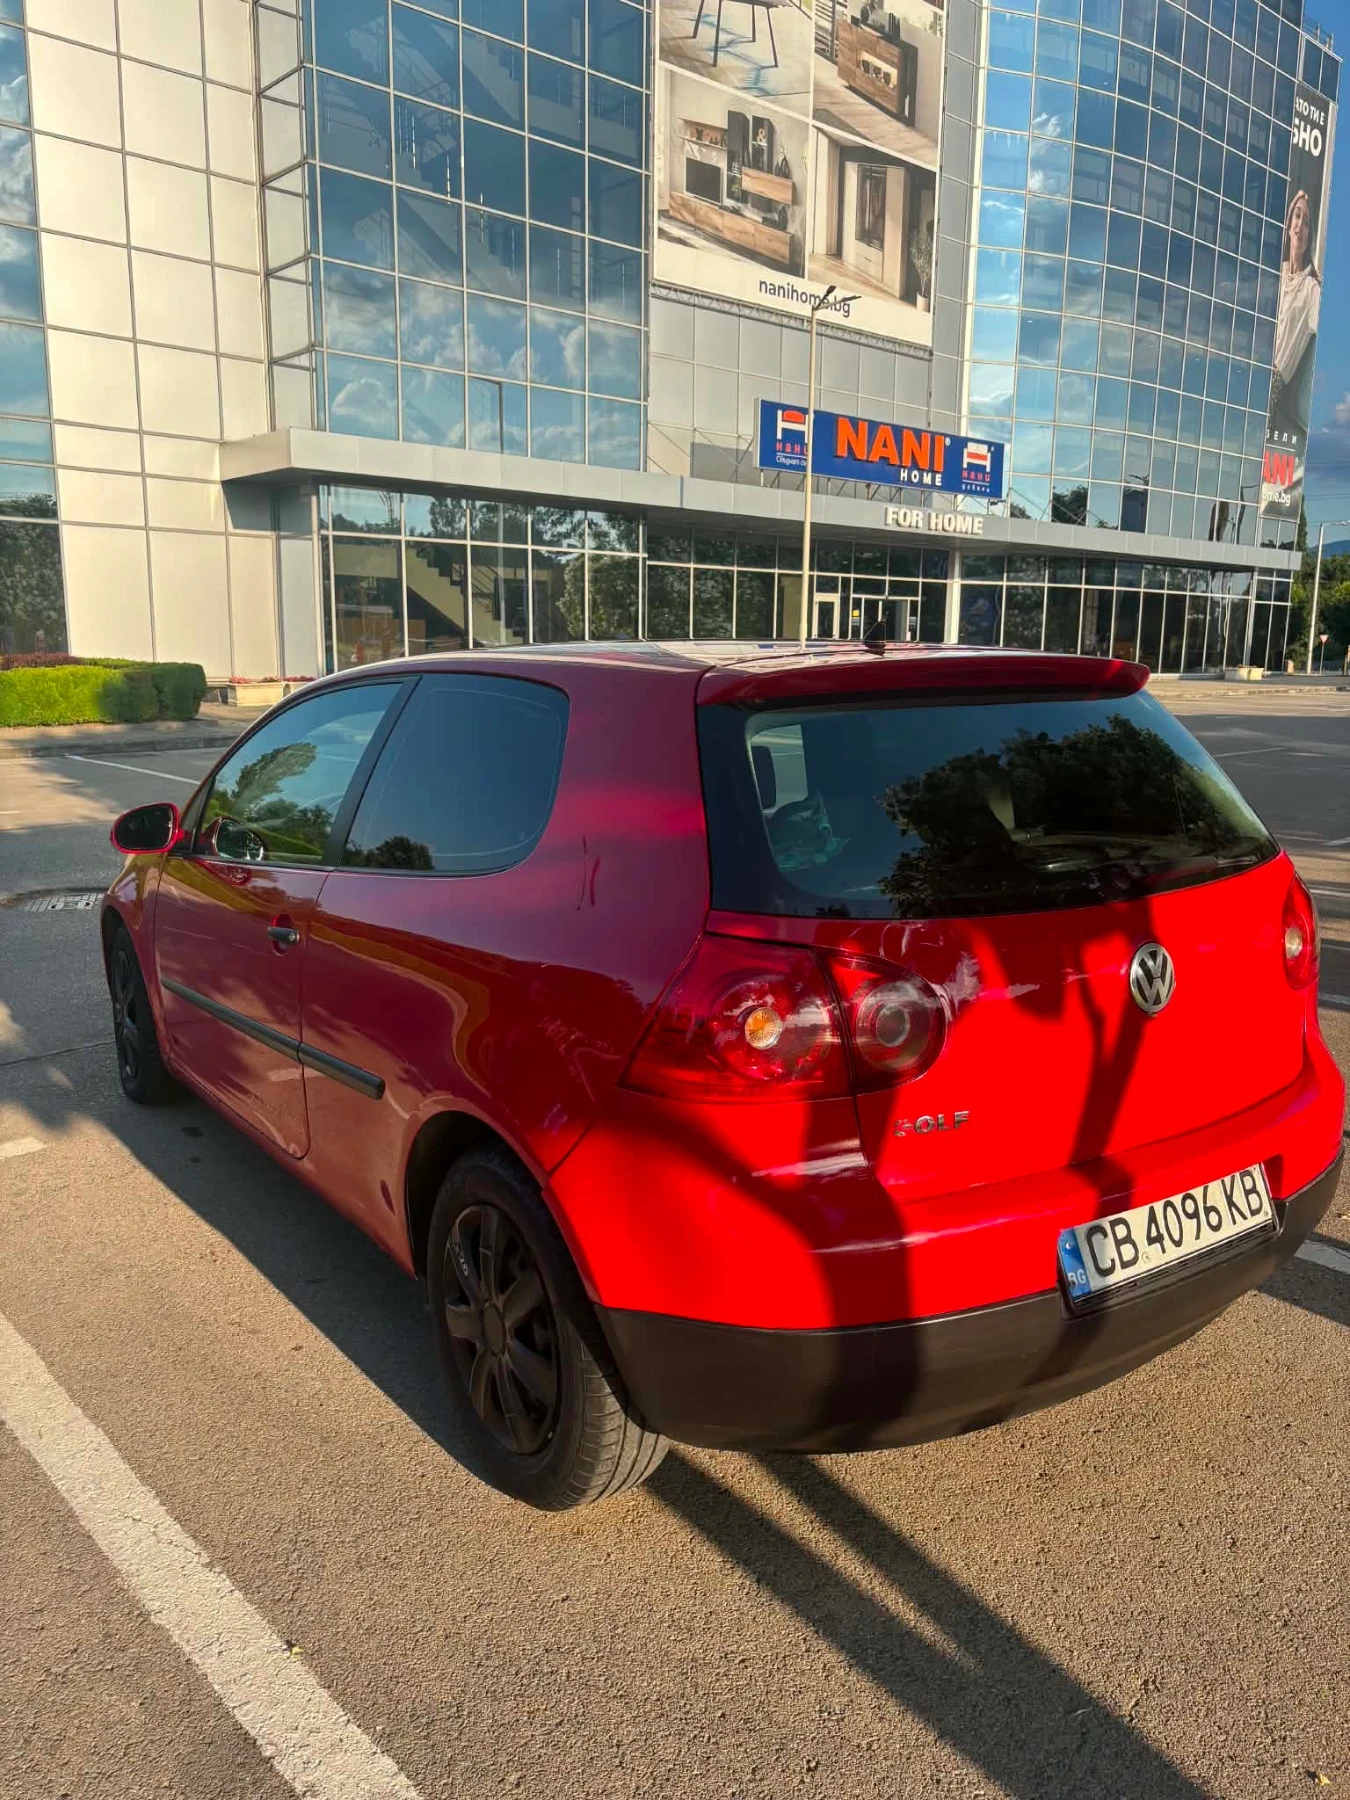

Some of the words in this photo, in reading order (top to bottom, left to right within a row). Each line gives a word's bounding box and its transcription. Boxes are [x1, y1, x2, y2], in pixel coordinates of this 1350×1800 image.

[836, 416, 945, 472] NANI
[900, 468, 942, 486] HOME
[885, 506, 923, 529] FOR
[928, 511, 984, 535] HOME
[1086, 1217, 1139, 1277] CB
[1145, 1184, 1223, 1255] 4096
[1221, 1169, 1263, 1226] KB
